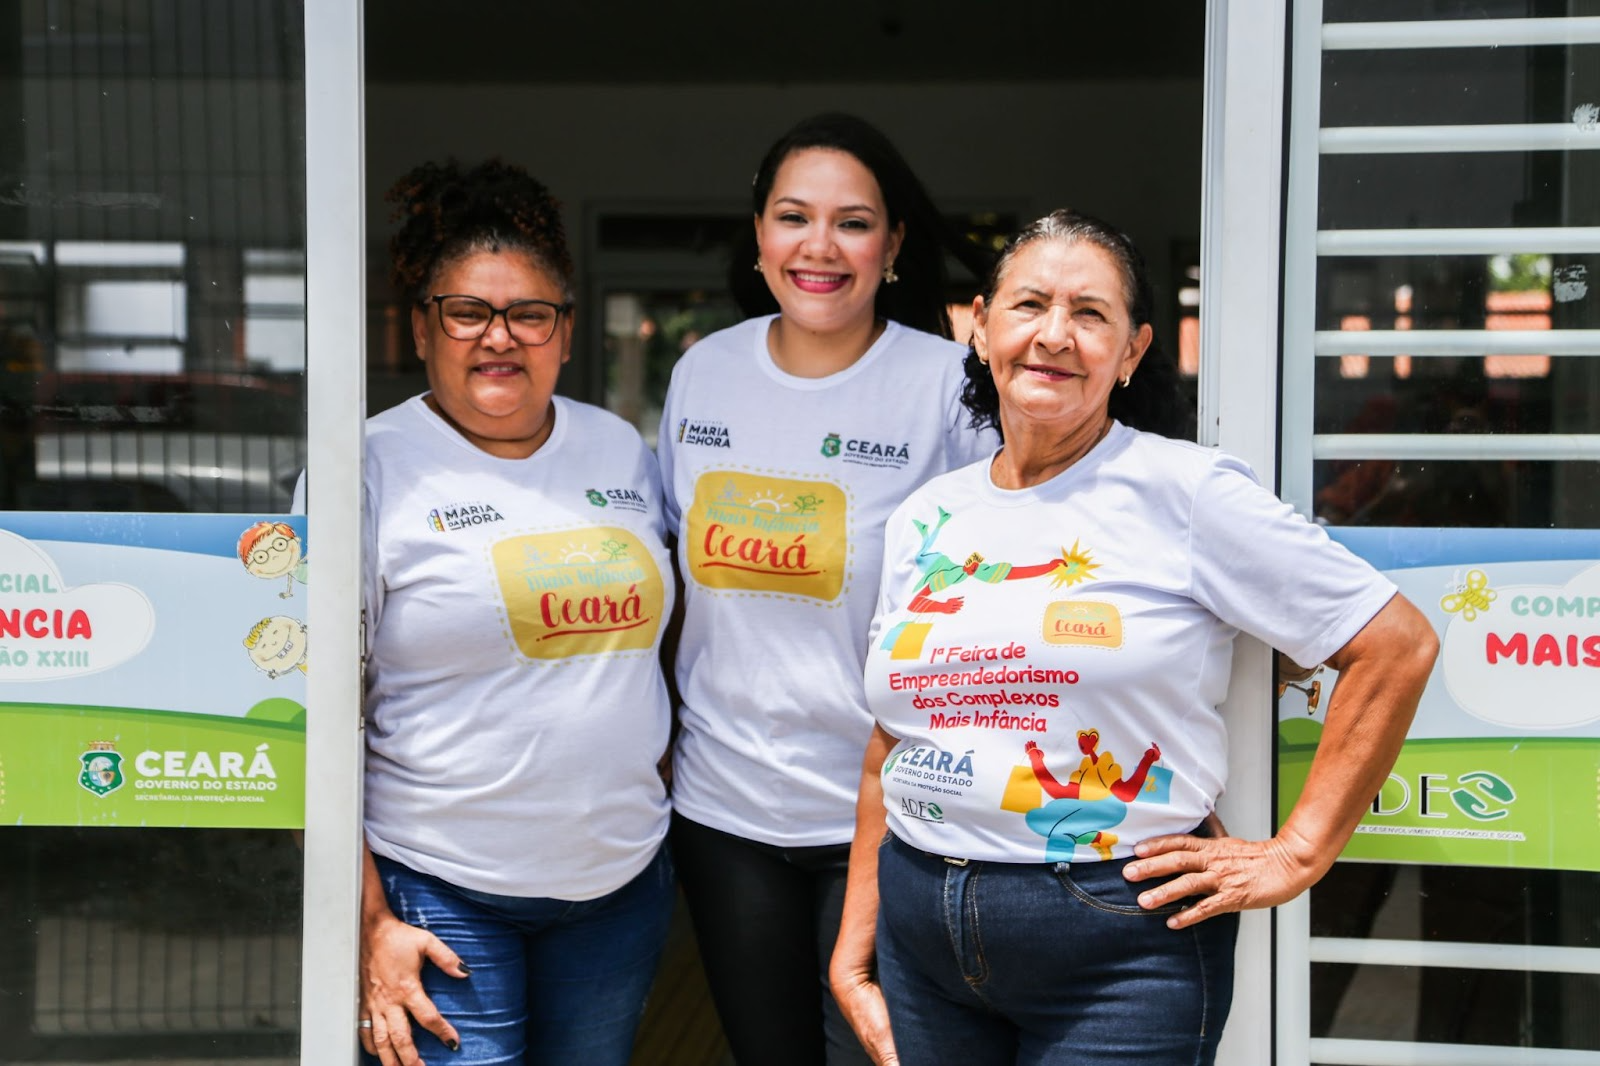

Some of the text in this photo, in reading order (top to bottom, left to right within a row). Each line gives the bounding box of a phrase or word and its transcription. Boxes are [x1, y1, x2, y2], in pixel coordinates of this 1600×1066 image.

[689, 424, 729, 437] MARIA
[695, 436, 731, 449] HORA
[846, 439, 909, 460] CEARÁ
[844, 452, 873, 461] GOVERNO
[444, 504, 495, 521] MARIA
[460, 512, 505, 528] HORA
[704, 523, 813, 570] Ceará
[0, 573, 58, 594] CIAL
[540, 583, 646, 628] Ceará
[1510, 595, 1600, 618] COMP
[0, 608, 92, 640] NCIA
[1055, 619, 1110, 636] Ceará
[37, 650, 89, 667] XXIII
[946, 645, 998, 663] Feira
[1000, 641, 1026, 660] de
[1486, 632, 1600, 668] MAIS
[888, 664, 1080, 693] Empreendedorismo
[912, 689, 1060, 710] dos Complexos
[929, 709, 1048, 733] Mais Infância
[135, 743, 277, 779] CEARÁ
[901, 747, 975, 778] CEARÁ
[134, 779, 277, 791] GOVERNO DO ESTADO
[894, 765, 973, 788] GOVERNO DO ESTADO
[917, 783, 942, 793] PROTEÇÃO
[943, 788, 963, 797] SOCIAL
[1368, 826, 1441, 836] DESENVOLVIMENTO
